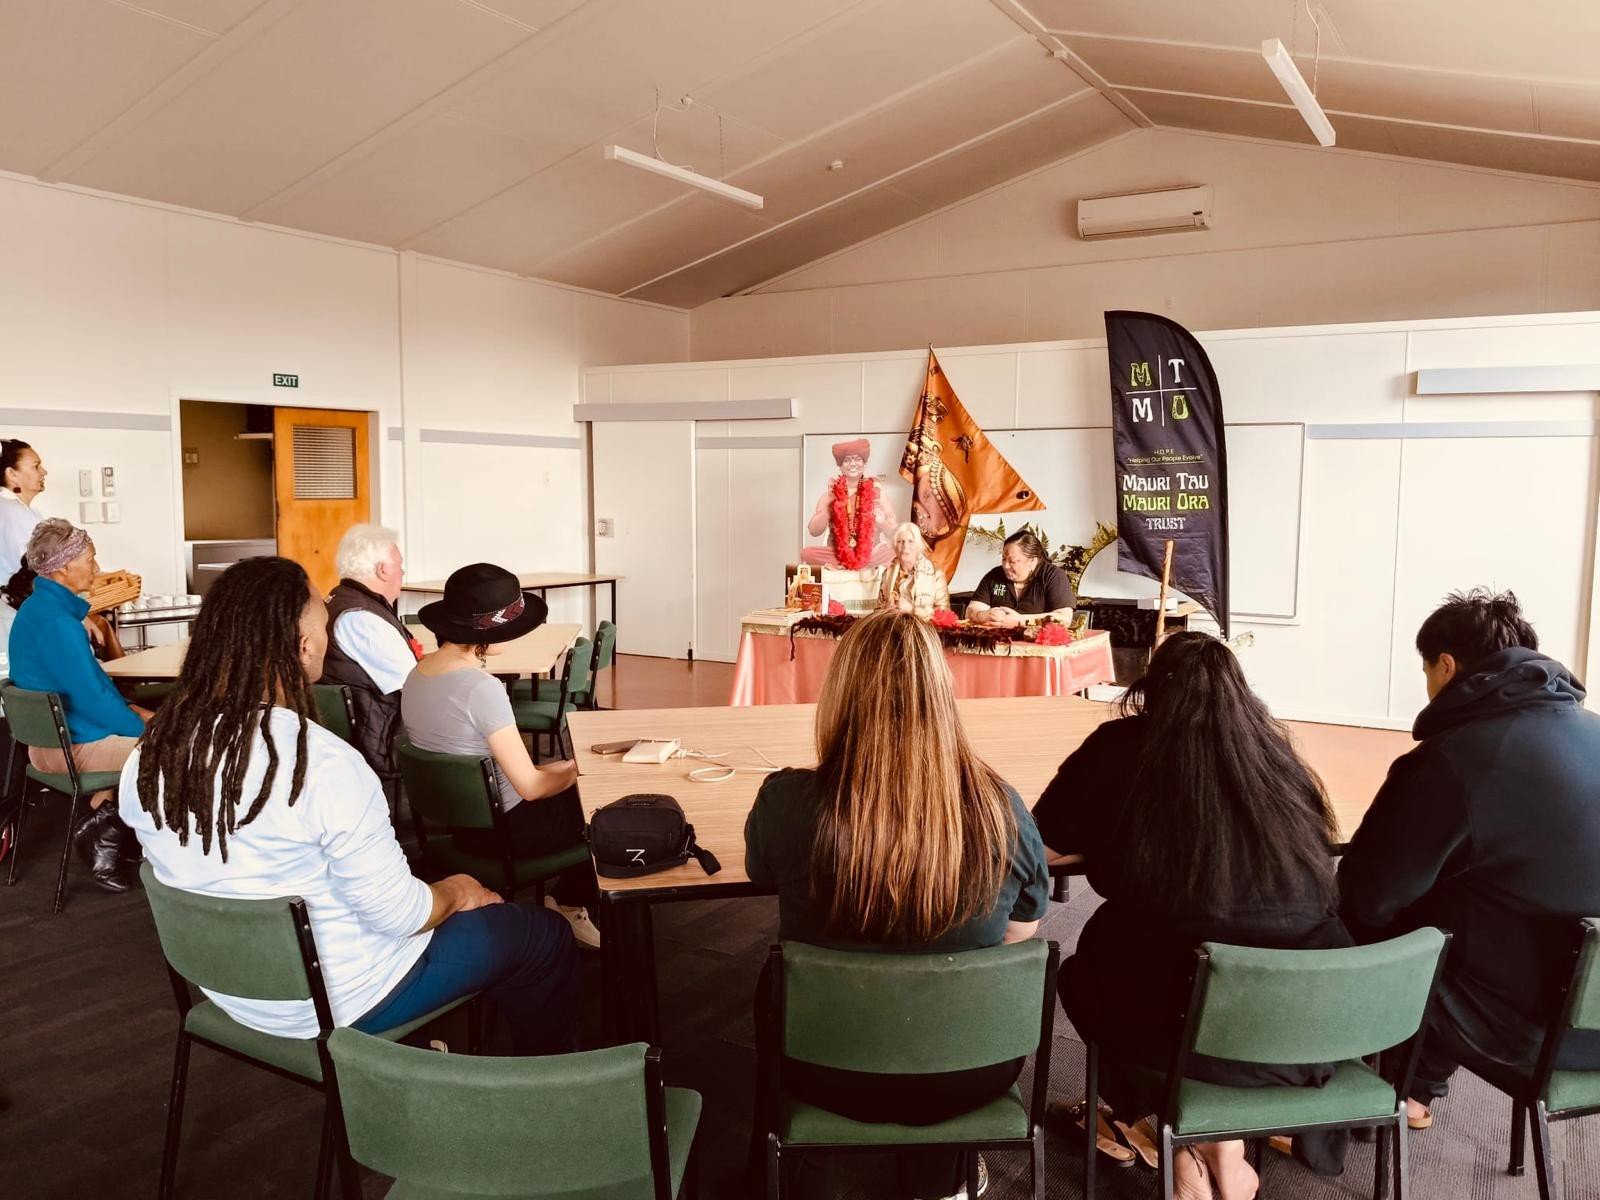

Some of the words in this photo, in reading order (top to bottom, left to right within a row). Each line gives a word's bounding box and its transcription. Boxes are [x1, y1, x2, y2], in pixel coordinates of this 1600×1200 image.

[275, 375, 297, 386] EXIT
[1131, 362, 1152, 387] M
[1168, 359, 1185, 383] T
[1132, 397, 1153, 423] M
[1145, 517, 1186, 530] TRUST
